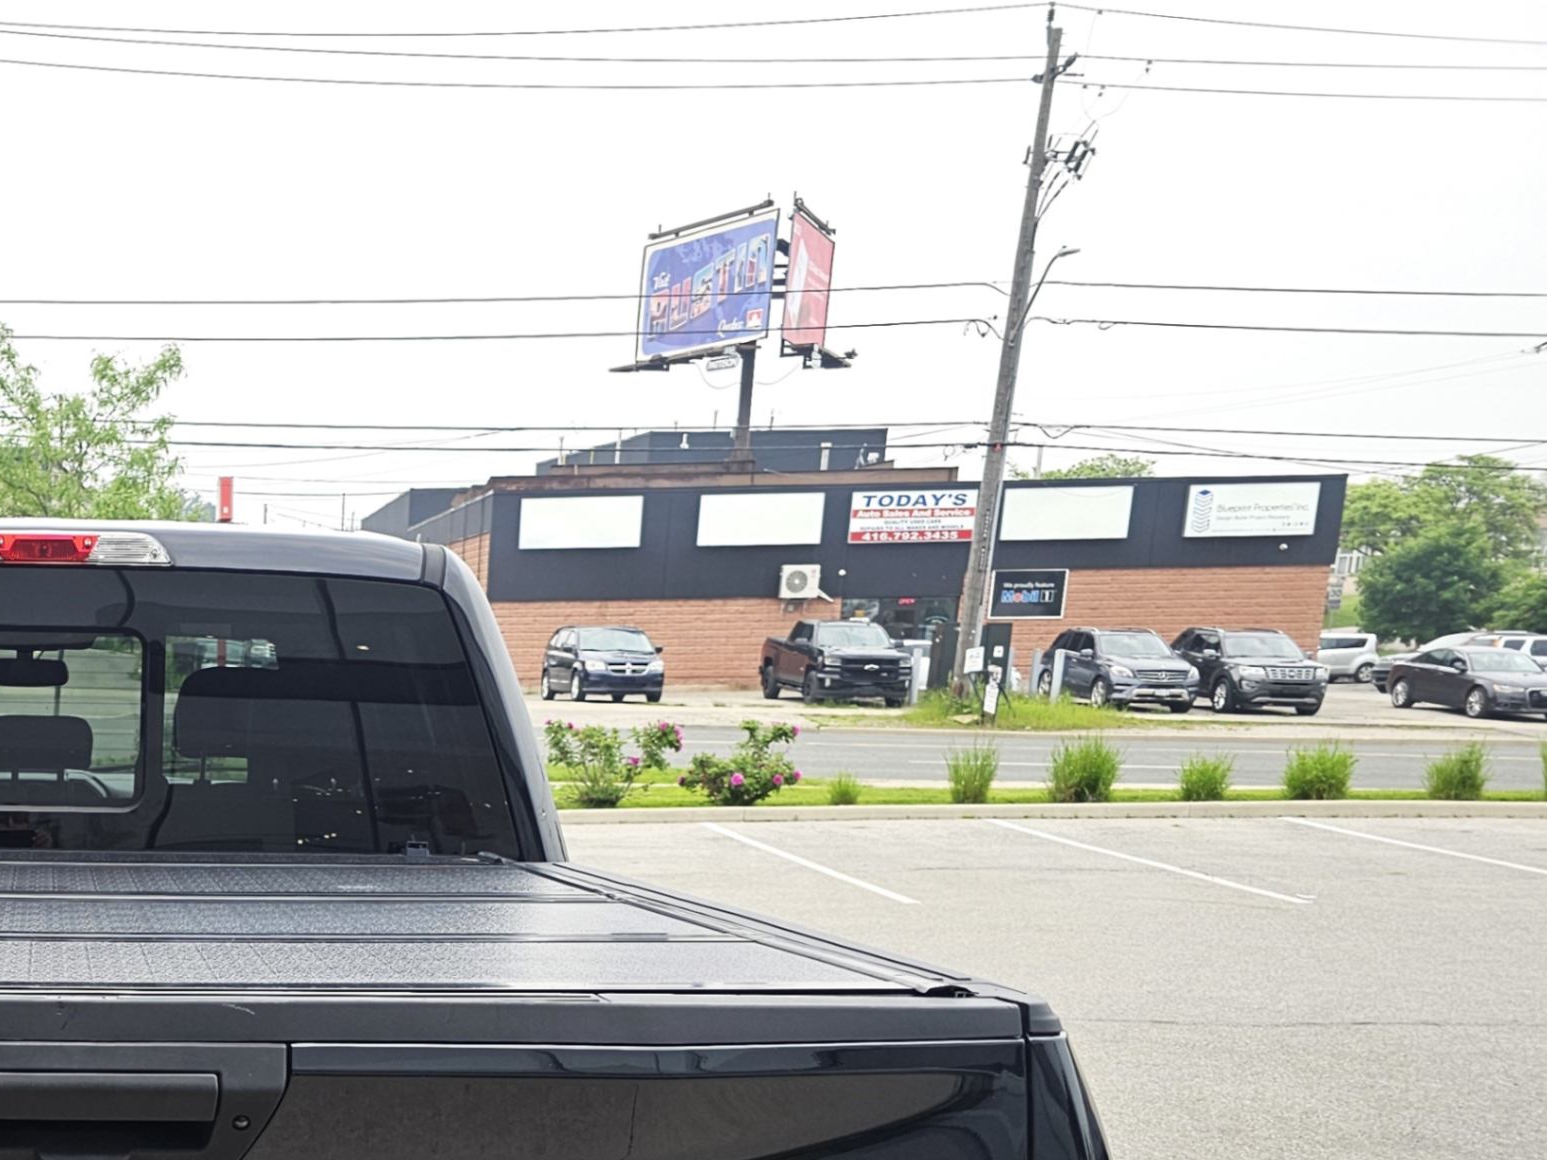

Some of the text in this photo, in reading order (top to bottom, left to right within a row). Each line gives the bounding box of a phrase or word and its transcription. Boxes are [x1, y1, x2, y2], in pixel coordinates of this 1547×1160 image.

[862, 493, 968, 508] TODAY'S
[856, 508, 971, 518] Auto Sales And Service
[861, 531, 958, 541] 416.792.3435
[1001, 590, 1040, 603] Mobil
